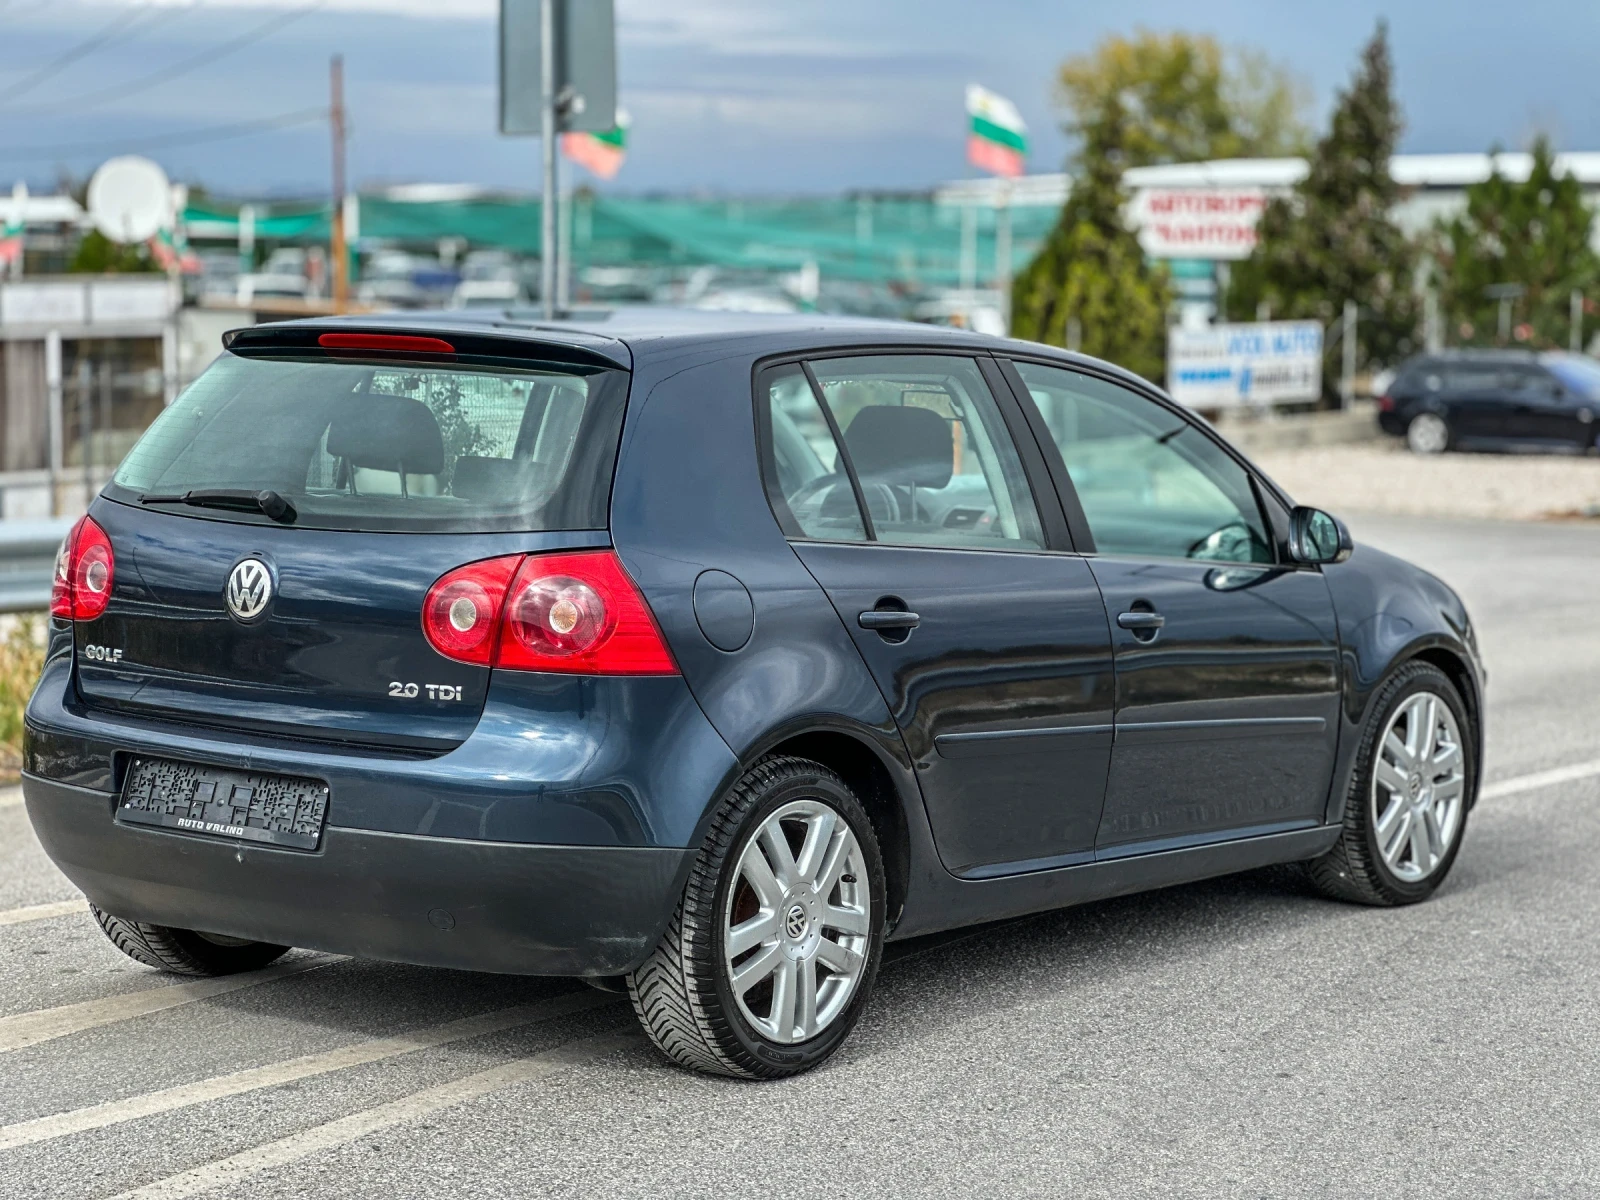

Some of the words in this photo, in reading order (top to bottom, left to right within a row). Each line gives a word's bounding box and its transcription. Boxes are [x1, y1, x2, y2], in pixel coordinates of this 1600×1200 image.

[85, 644, 123, 663] GOLF
[425, 683, 462, 701] TDI
[177, 817, 204, 829] AUTO
